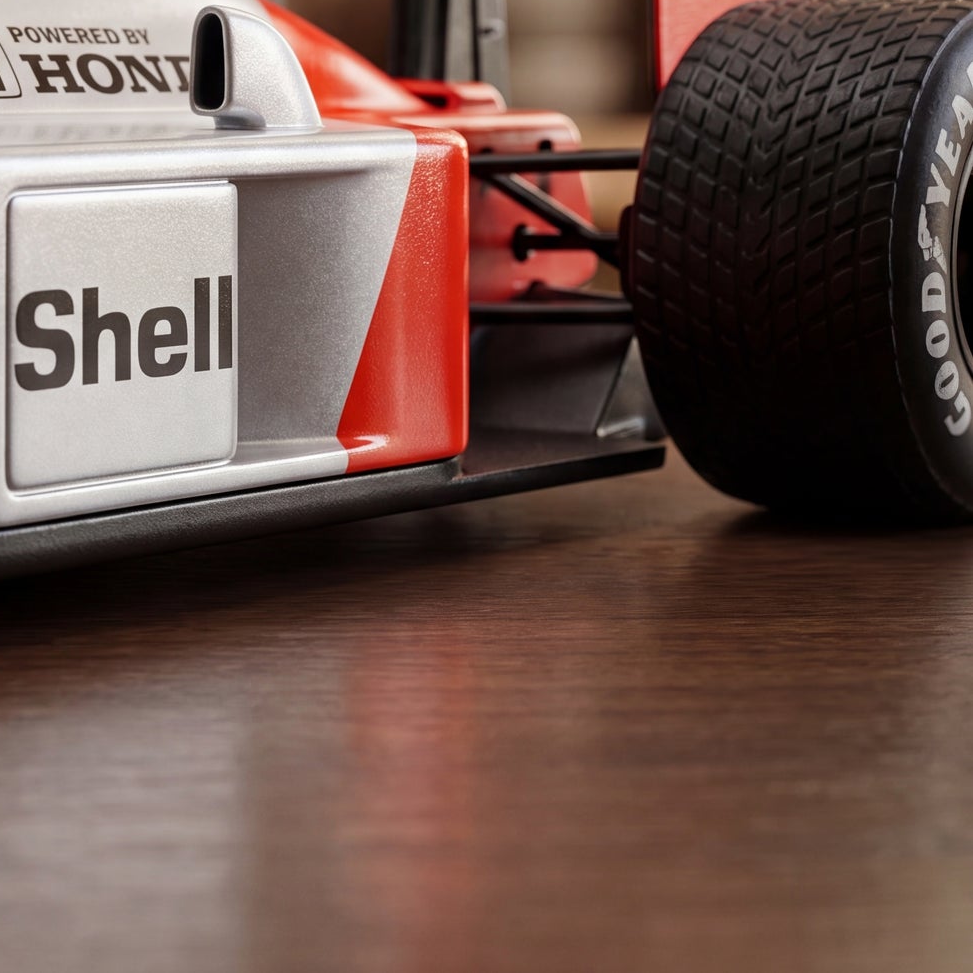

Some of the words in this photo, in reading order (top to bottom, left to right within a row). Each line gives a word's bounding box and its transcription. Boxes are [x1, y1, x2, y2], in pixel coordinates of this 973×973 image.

[6, 26, 121, 44] POWERED
[121, 28, 150, 45] BY
[919, 61, 973, 436] GOODYEA
[14, 274, 233, 391] Shell
